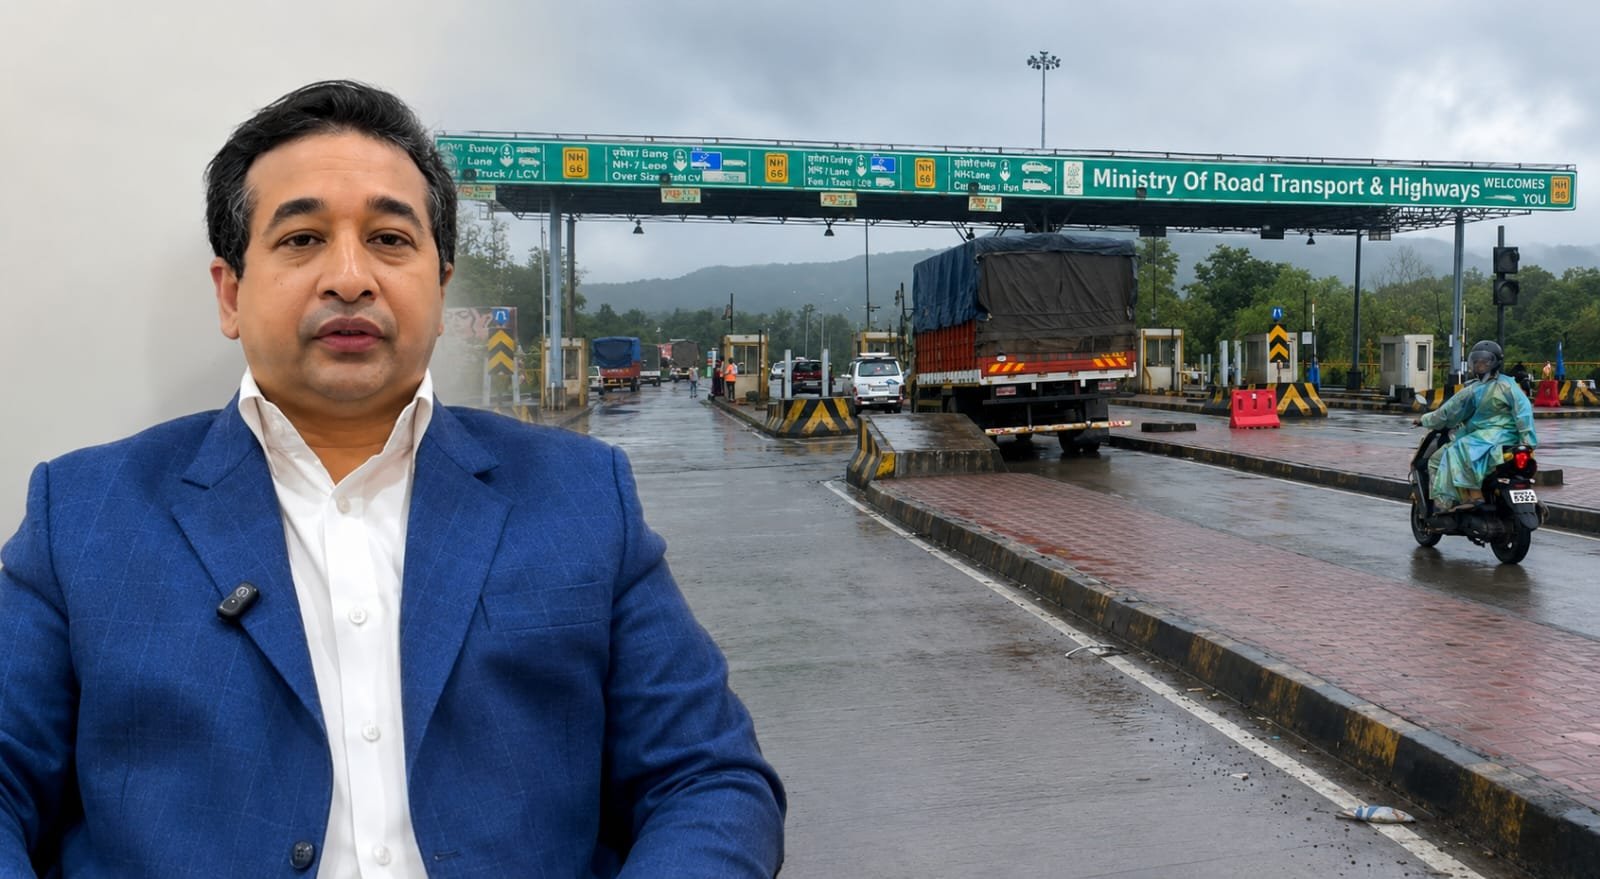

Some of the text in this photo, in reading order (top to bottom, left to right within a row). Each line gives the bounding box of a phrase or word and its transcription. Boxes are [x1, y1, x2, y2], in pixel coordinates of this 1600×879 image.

[568, 153, 584, 161] NH
[769, 159, 784, 167] NH
[569, 165, 583, 173] 66
[918, 164, 932, 172] NH
[474, 168, 505, 178] Truck
[516, 170, 540, 179] LCV
[612, 171, 637, 180] Over
[770, 170, 784, 178] 66
[919, 175, 931, 183] 66
[1483, 177, 1545, 189] WELCOMES
[1093, 168, 1480, 202] Ministry Of Road Transport & Highways
[1554, 181, 1567, 189] NH
[1522, 193, 1546, 205] YOU
